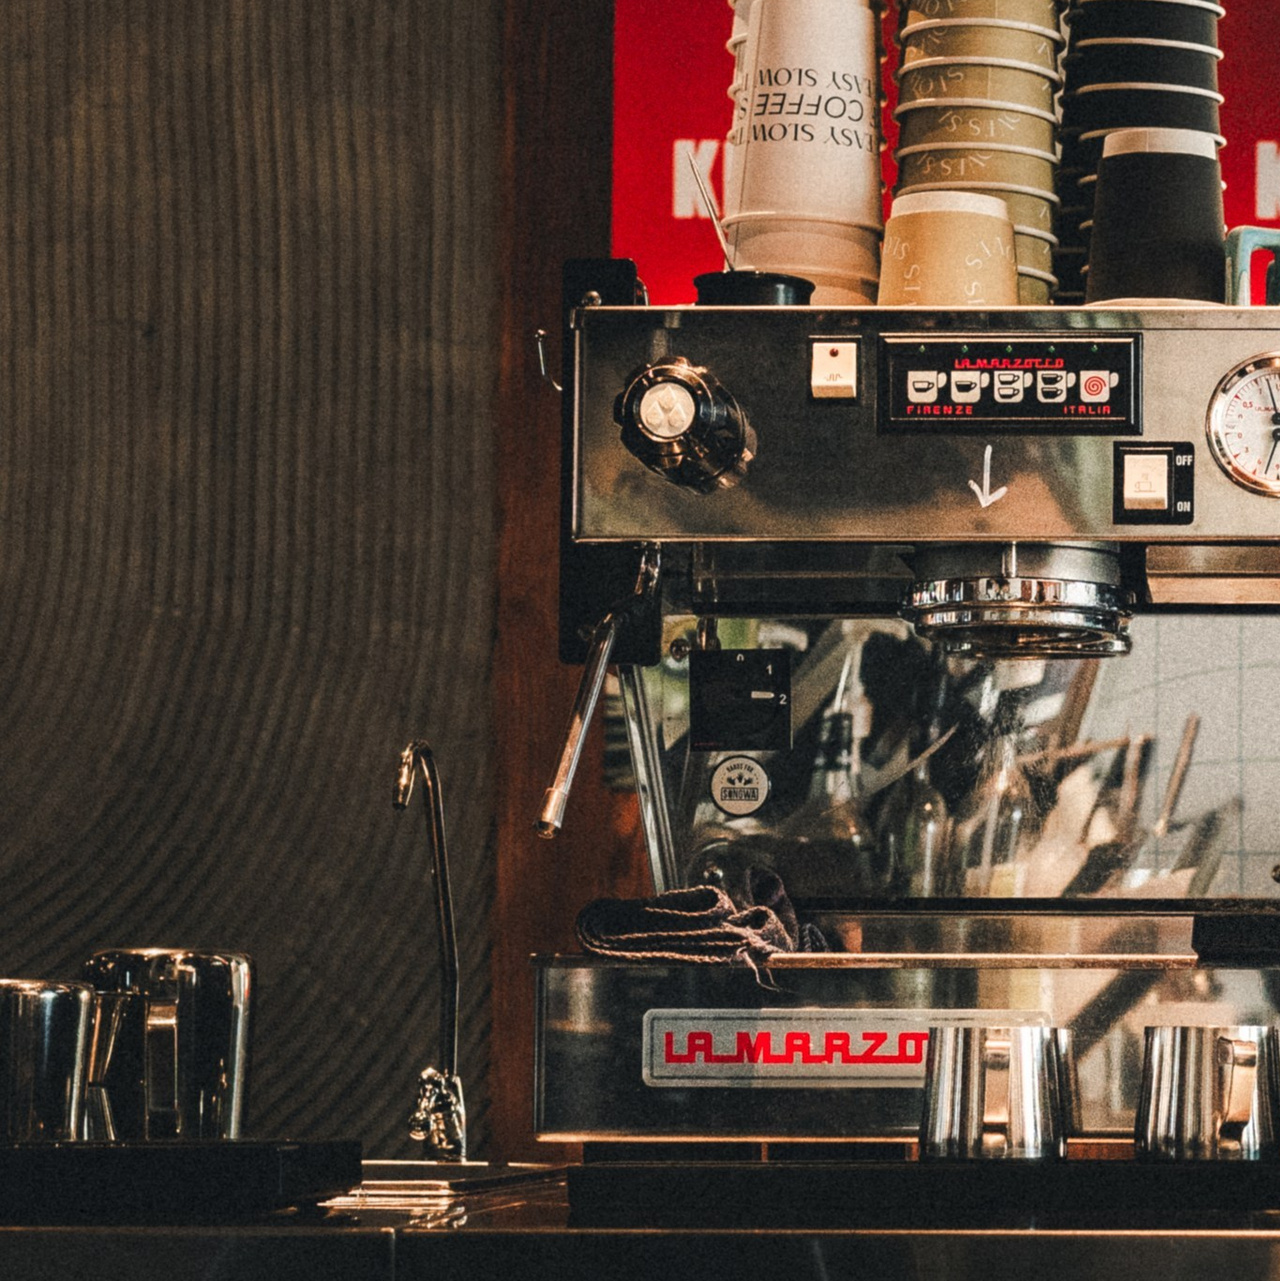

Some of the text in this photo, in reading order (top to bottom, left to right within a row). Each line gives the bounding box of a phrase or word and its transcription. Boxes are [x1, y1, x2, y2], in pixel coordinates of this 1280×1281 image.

[754, 93, 864, 122] COFFEE
[906, 405, 1111, 415] FIRENZE ITALIA
[1175, 455, 1193, 466] OFF
[1176, 501, 1191, 512] ON
[766, 664, 773, 675] 1
[779, 694, 788, 705] 2
[664, 1031, 929, 1064] LA MARZO
